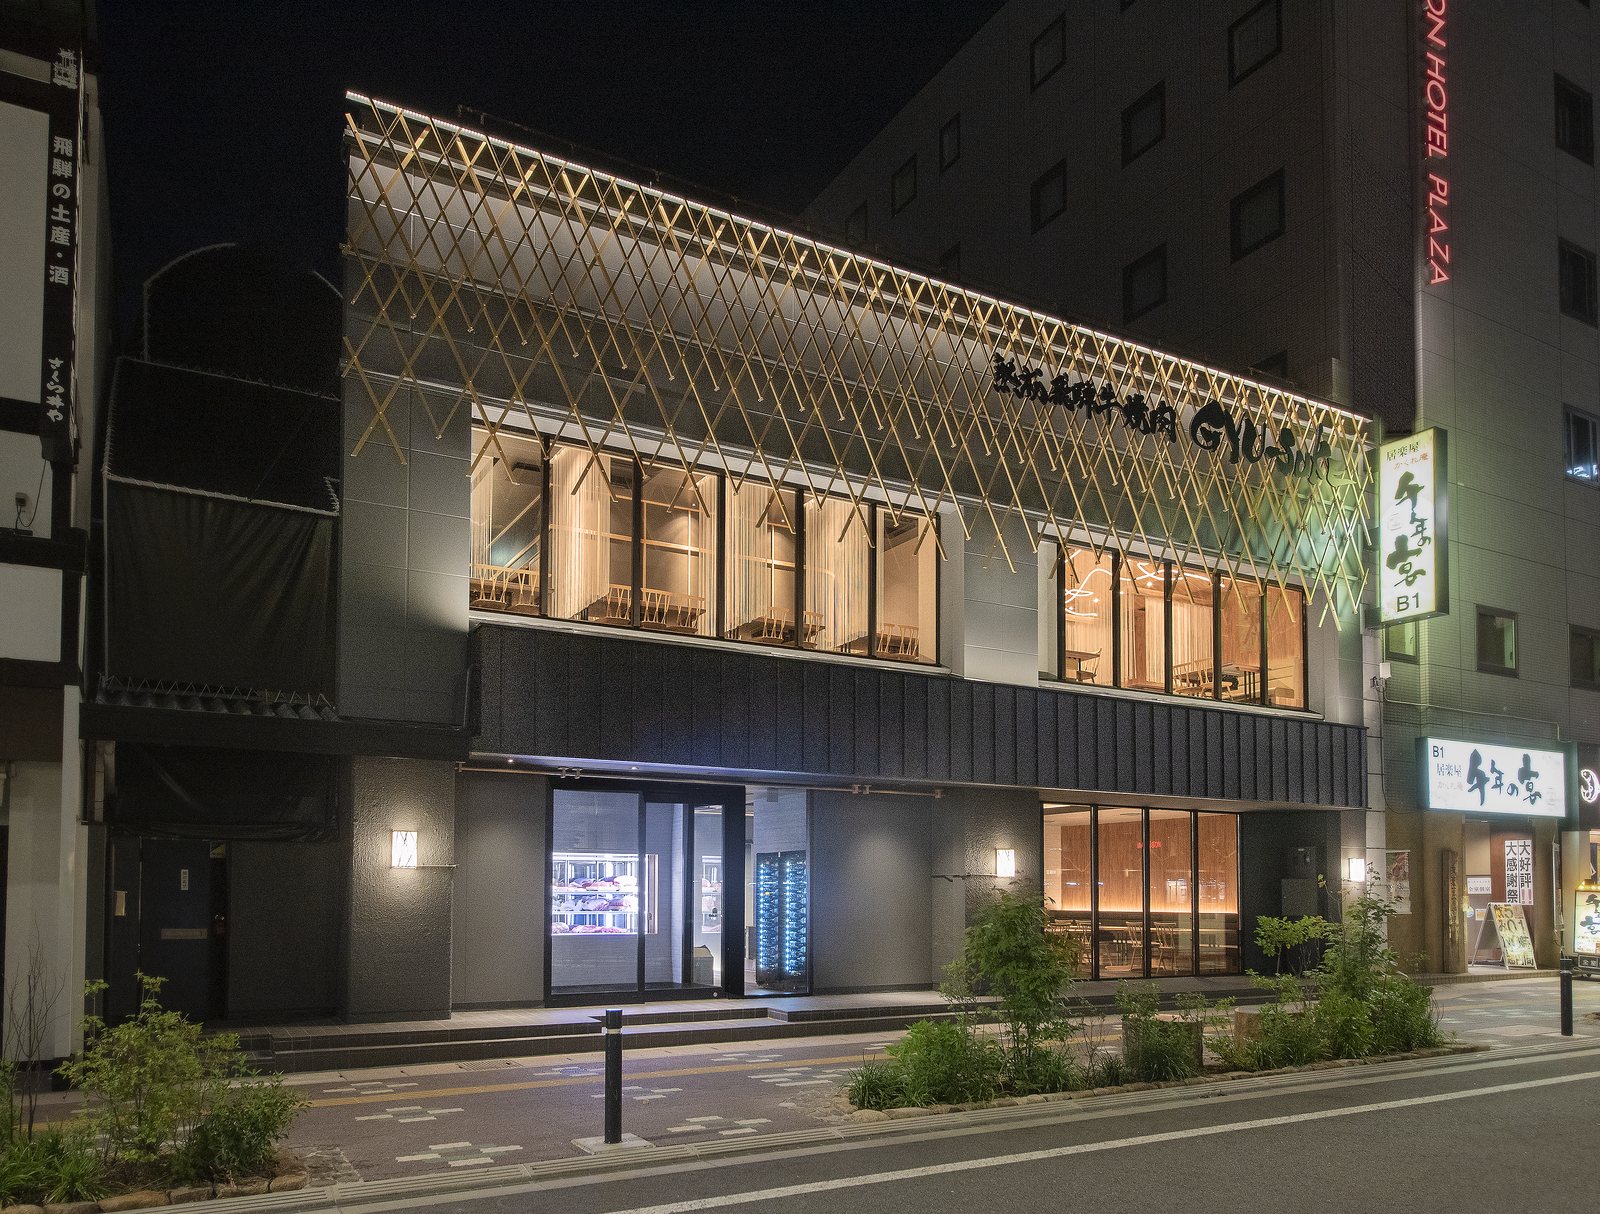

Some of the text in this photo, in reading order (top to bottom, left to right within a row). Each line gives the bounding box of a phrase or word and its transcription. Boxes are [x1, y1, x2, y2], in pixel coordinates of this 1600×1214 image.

[1426, 52, 1448, 157] HOTEL
[49, 136, 73, 286] 飛騨の土産・酒
[1428, 173, 1450, 285] PLAZA
[1396, 592, 1421, 613] B1
[1432, 745, 1445, 758] B1
[1505, 841, 1518, 903] 大感謝祭
